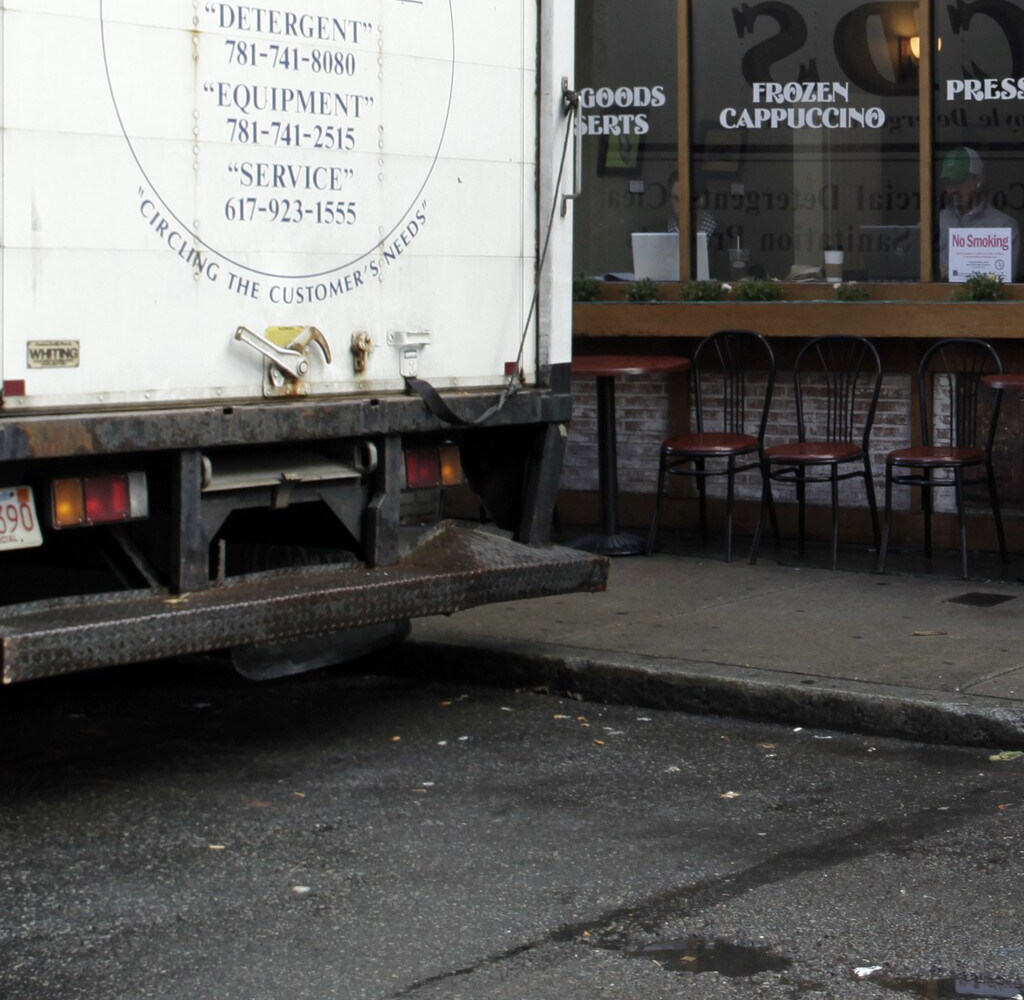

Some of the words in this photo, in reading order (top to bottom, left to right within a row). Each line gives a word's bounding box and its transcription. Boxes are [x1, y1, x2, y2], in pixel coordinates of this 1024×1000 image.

[225, 39, 356, 76] 781-741-8080
[580, 86, 666, 108] GOODS
[752, 82, 848, 104] FROZEN
[719, 107, 886, 129] CAPPUCCINO
[226, 118, 356, 151] 781-741-2515
[225, 197, 357, 225] 617-923-1555
[952, 234, 965, 248] No
[967, 234, 1009, 251] Smoking
[227, 272, 260, 299] THE
[269, 260, 380, 304] CUSTOMER'S
